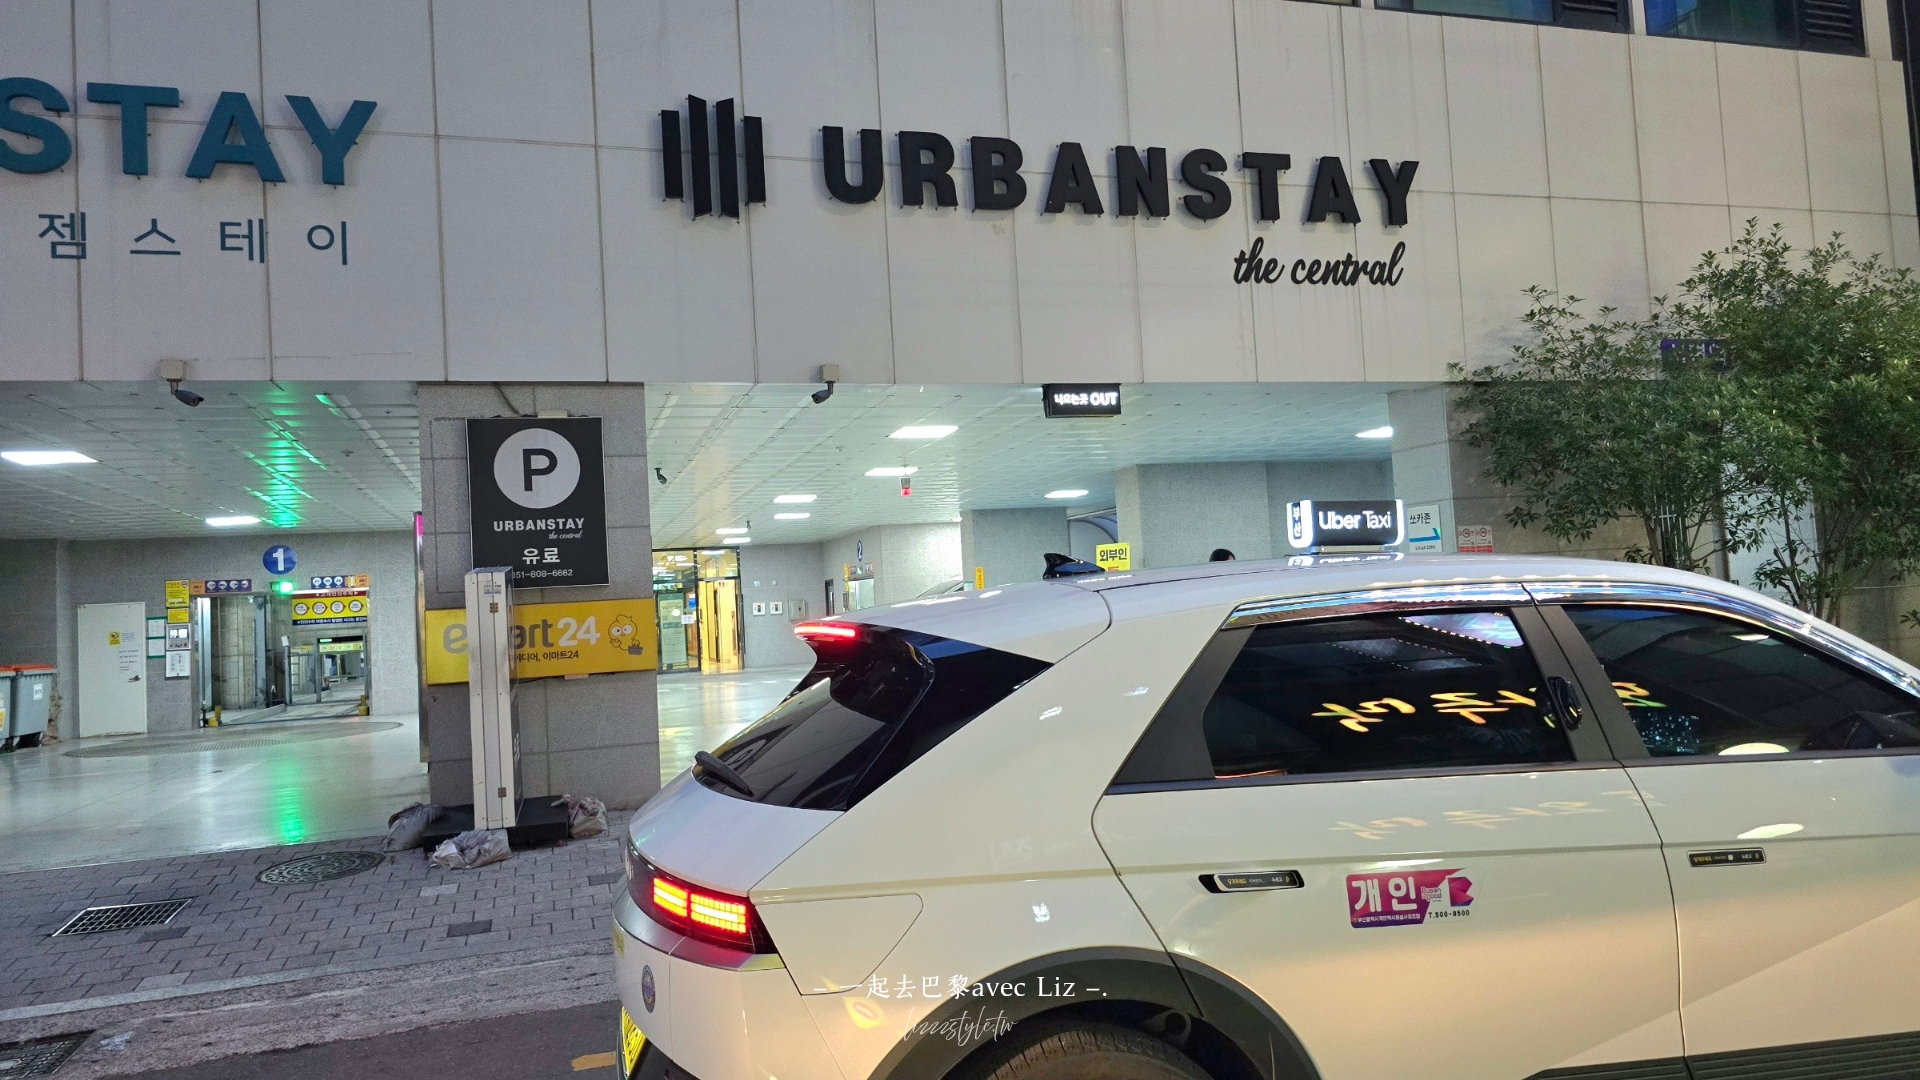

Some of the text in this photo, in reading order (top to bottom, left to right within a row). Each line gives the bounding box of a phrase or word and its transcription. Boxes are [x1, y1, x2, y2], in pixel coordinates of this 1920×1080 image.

[0, 77, 378, 186] STAY
[821, 125, 1420, 226] URBANSTAY
[1233, 237, 1406, 287] the central
[1090, 392, 1118, 406] OUT
[522, 448, 557, 492] P
[493, 517, 585, 532] URBANSTAY
[1293, 506, 1302, 537] 부산
[1318, 510, 1391, 530] Uber Taxi
[548, 530, 583, 540] the central
[273, 548, 285, 571] 1
[521, 547, 561, 565] 유료
[1099, 547, 1127, 562] 외부인
[511, 568, 574, 579] 051-808-6662
[443, 614, 600, 654] eart24
[542, 650, 579, 661] 이마트24
